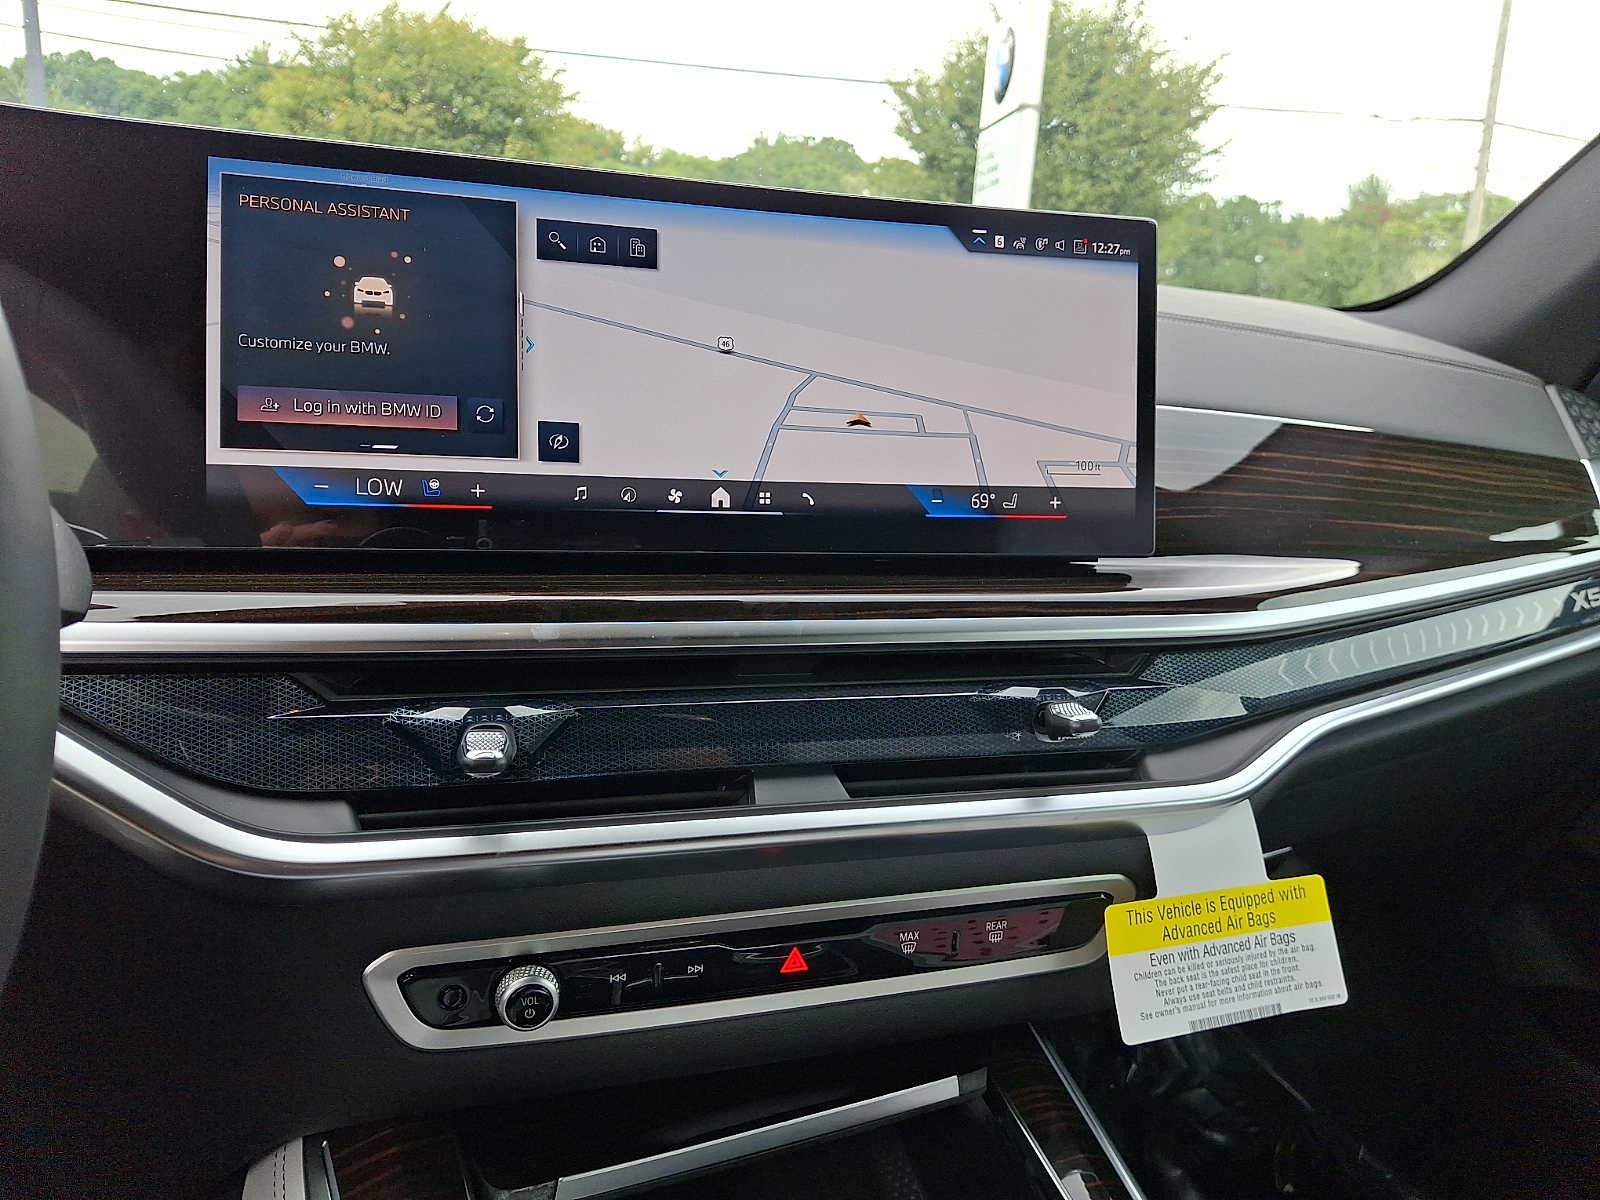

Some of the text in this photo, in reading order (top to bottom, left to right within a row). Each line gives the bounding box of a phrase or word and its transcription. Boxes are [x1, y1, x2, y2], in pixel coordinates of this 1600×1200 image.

[239, 194, 411, 221] PERSONAL ASSISTANT
[238, 333, 391, 356] Customize your BMW.
[294, 398, 441, 418] Log in with BMW ID
[355, 478, 403, 496] LOW
[1126, 884, 1307, 926] This Vehicle is Equipped with
[900, 930, 920, 941] MAX
[985, 920, 1008, 932] REAR
[1162, 911, 1276, 941] Advanced Air Bags
[1149, 932, 1296, 967] Even with Advanced Air Bags
[1134, 970, 1162, 981] Children
[1164, 968, 1176, 976] can
[1177, 966, 1186, 974] be
[1187, 962, 1205, 972] killed
[1245, 950, 1267, 962] injured
[1268, 949, 1276, 958] by
[1155, 979, 1167, 988] The
[1169, 976, 1185, 986] back
[1186, 973, 1200, 982] seat
[1208, 969, 1219, 978] the
[1220, 965, 1240, 975] safest
[1241, 963, 1257, 973] place
[1259, 960, 1268, 968] for
[1156, 988, 1175, 998] Never
[1176, 985, 1188, 995] put
[1195, 978, 1230, 990] rear-facing
[1231, 974, 1247, 984] child
[1248, 971, 1262, 980] seat
[1163, 996, 1187, 1006] Always
[1202, 990, 1216, 999] seat
[1217, 987, 1233, 996] belts
[1247, 980, 1263, 989] child
[521, 997, 539, 1006] VOL
[1140, 1012, 1153, 1021] See
[1182, 1002, 1206, 1013] manual
[1208, 999, 1217, 1008] for
[1274, 985, 1292, 994] about
[1294, 983, 1303, 991] air
